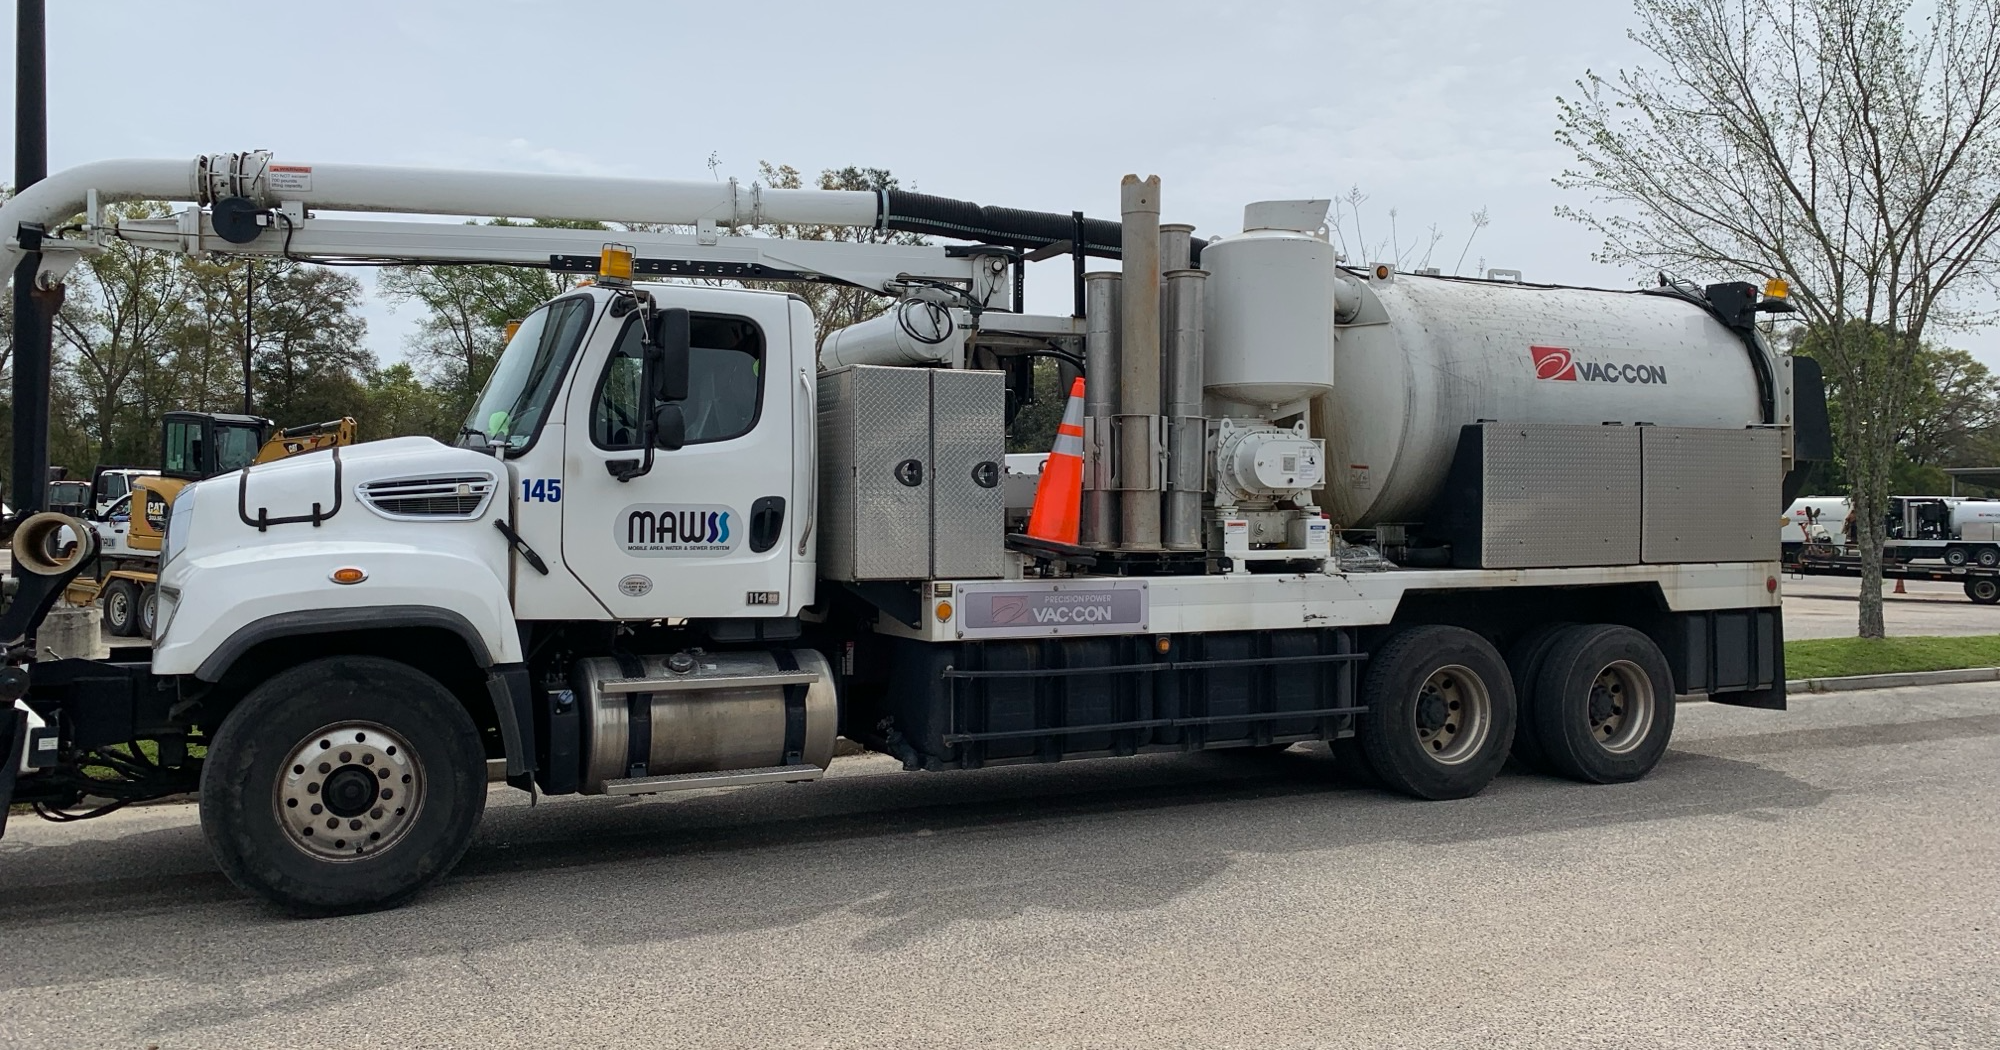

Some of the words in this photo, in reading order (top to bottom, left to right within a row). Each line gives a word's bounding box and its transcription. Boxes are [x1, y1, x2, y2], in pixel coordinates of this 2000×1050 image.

[522, 479, 561, 502] 145
[147, 502, 165, 515] CAT
[628, 511, 730, 543] MAWSS
[749, 593, 767, 604] 114
[1045, 595, 1084, 604] PRECISION
[1084, 594, 1112, 602] POWER
